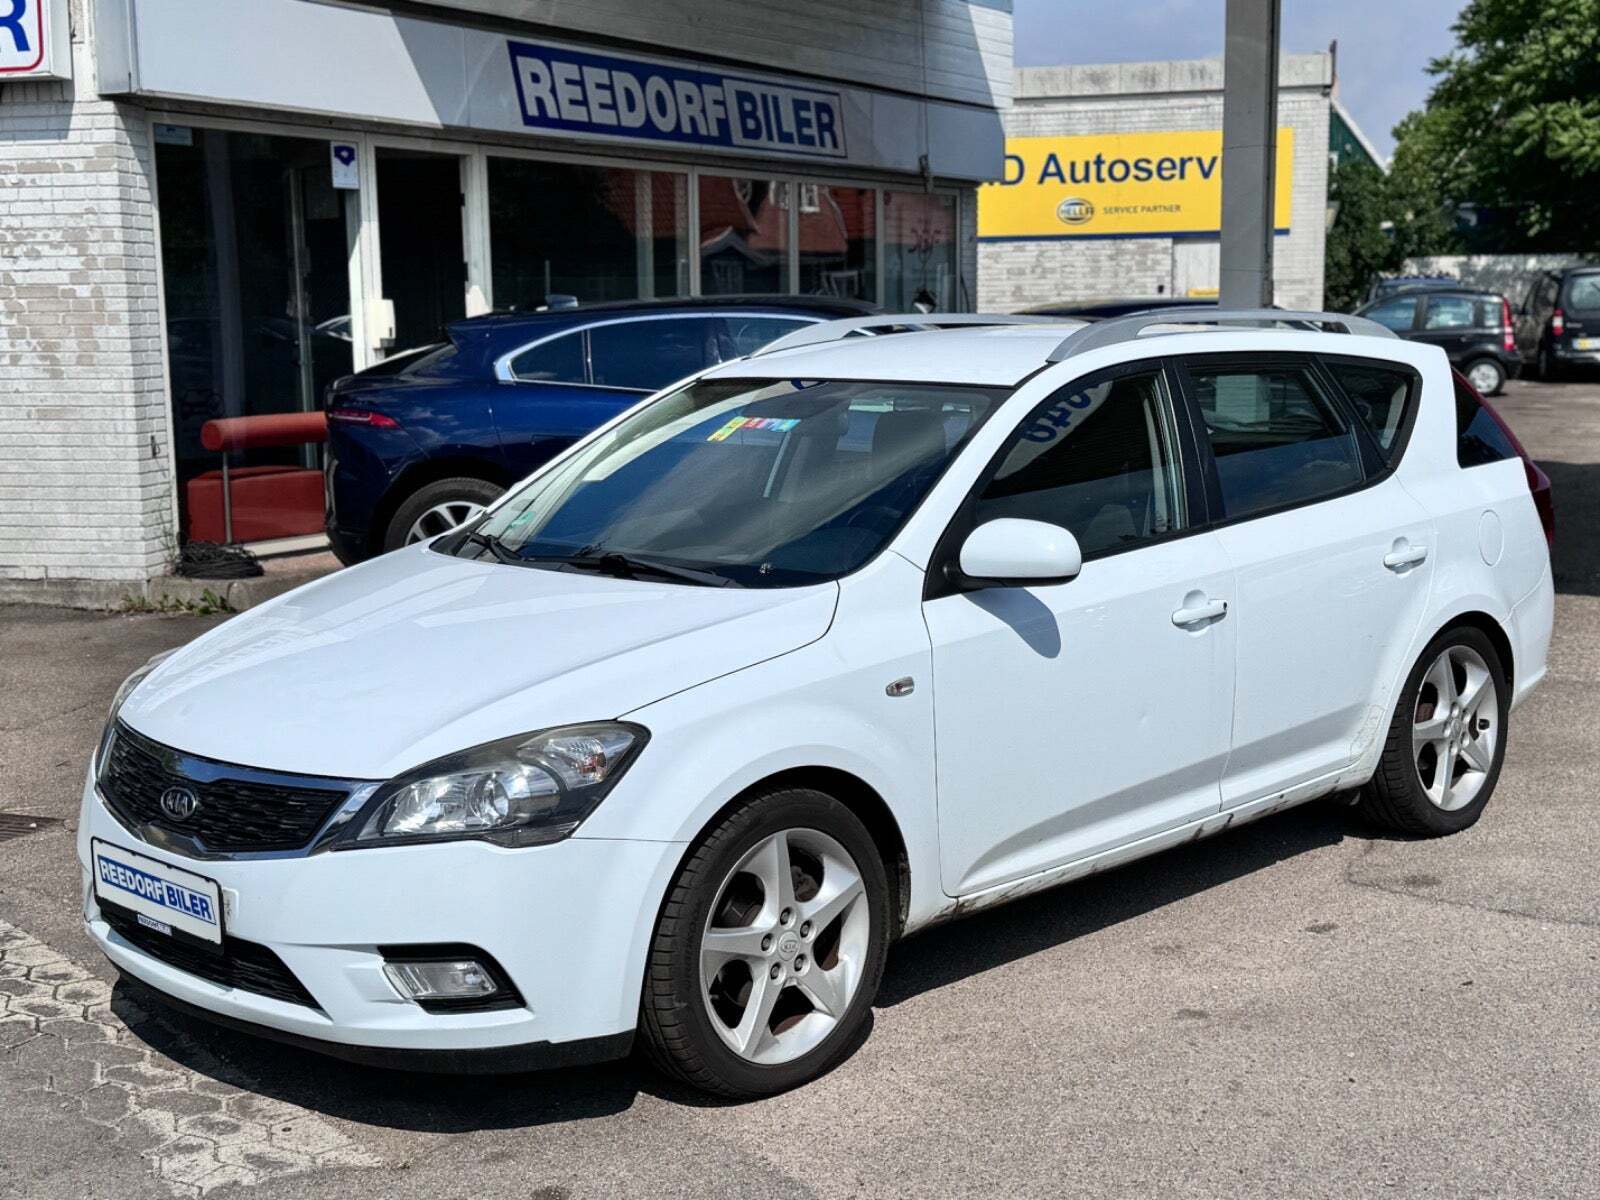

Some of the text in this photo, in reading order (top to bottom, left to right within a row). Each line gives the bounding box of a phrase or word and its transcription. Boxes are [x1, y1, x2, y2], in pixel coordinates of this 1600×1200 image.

[515, 55, 839, 149] REEDORF BILER
[1103, 203, 1181, 215] SERVICE PARTNER
[166, 791, 189, 816] KIA
[100, 860, 212, 920] REEDORF BILER
